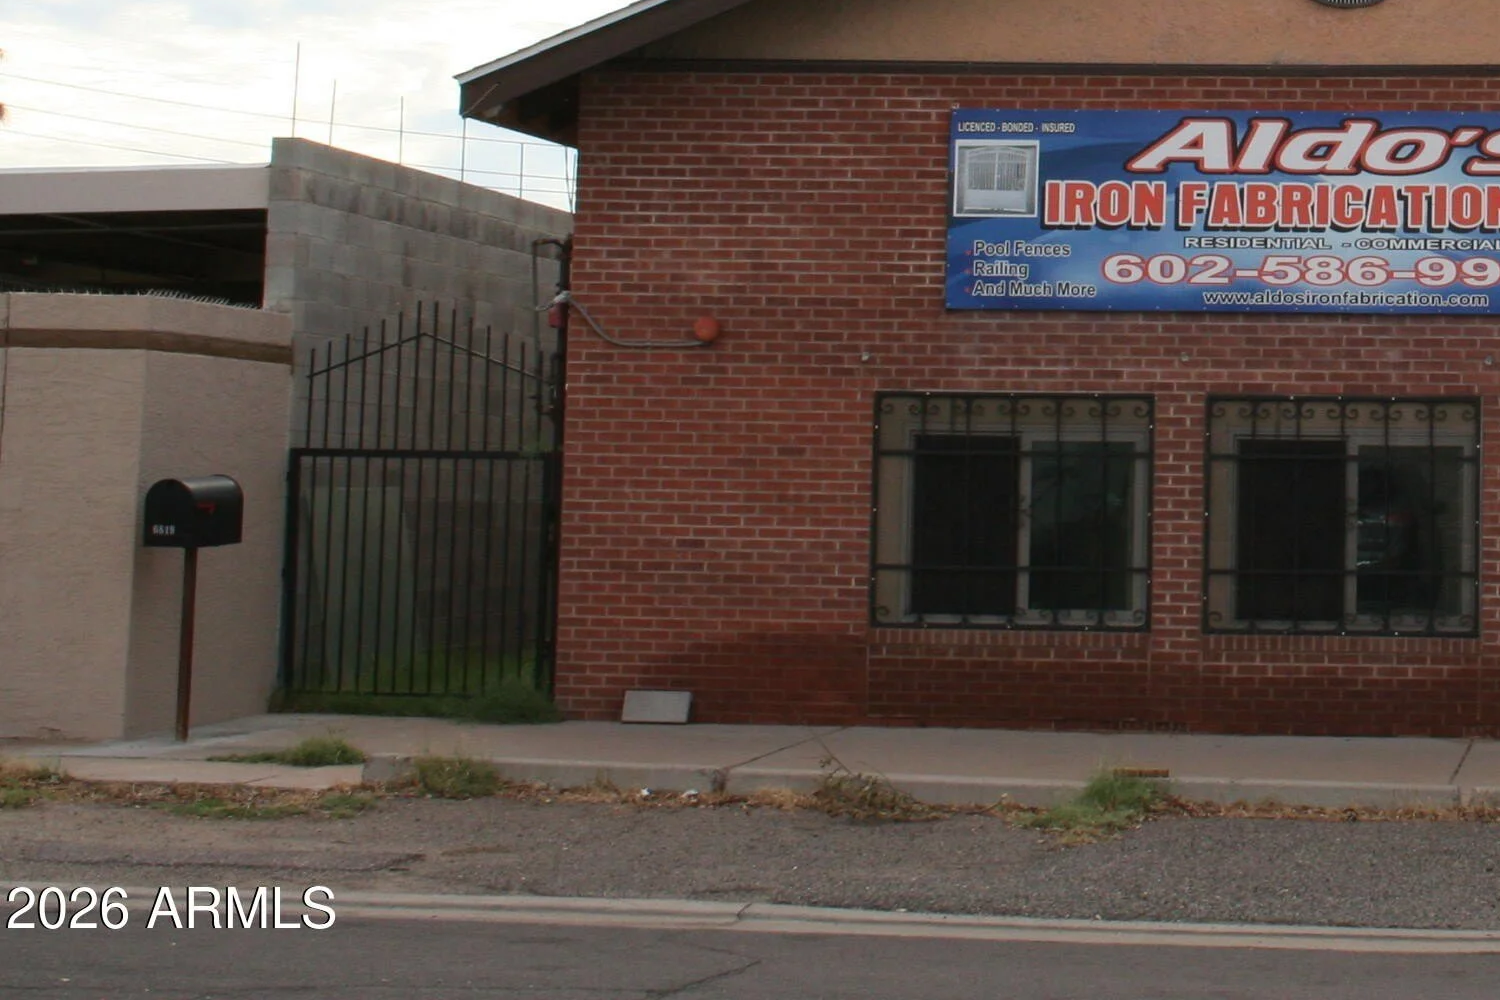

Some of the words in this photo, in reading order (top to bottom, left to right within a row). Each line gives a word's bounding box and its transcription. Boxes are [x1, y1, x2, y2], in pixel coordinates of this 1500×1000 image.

[958, 121, 996, 133] LICENCED
[1001, 122, 1034, 133] BONDED
[1041, 122, 1076, 133] INSURED
[1043, 181, 1166, 228] IRON
[974, 240, 1010, 256] Pool
[1014, 241, 1070, 257] Fences
[1183, 236, 1332, 249] RESIDENTIAL
[974, 260, 1028, 279] Railing
[972, 281, 1005, 297] And
[1009, 281, 1052, 297] Much
[1056, 282, 1096, 298] More
[1203, 289, 1489, 307] www.aldosironfabrication.com
